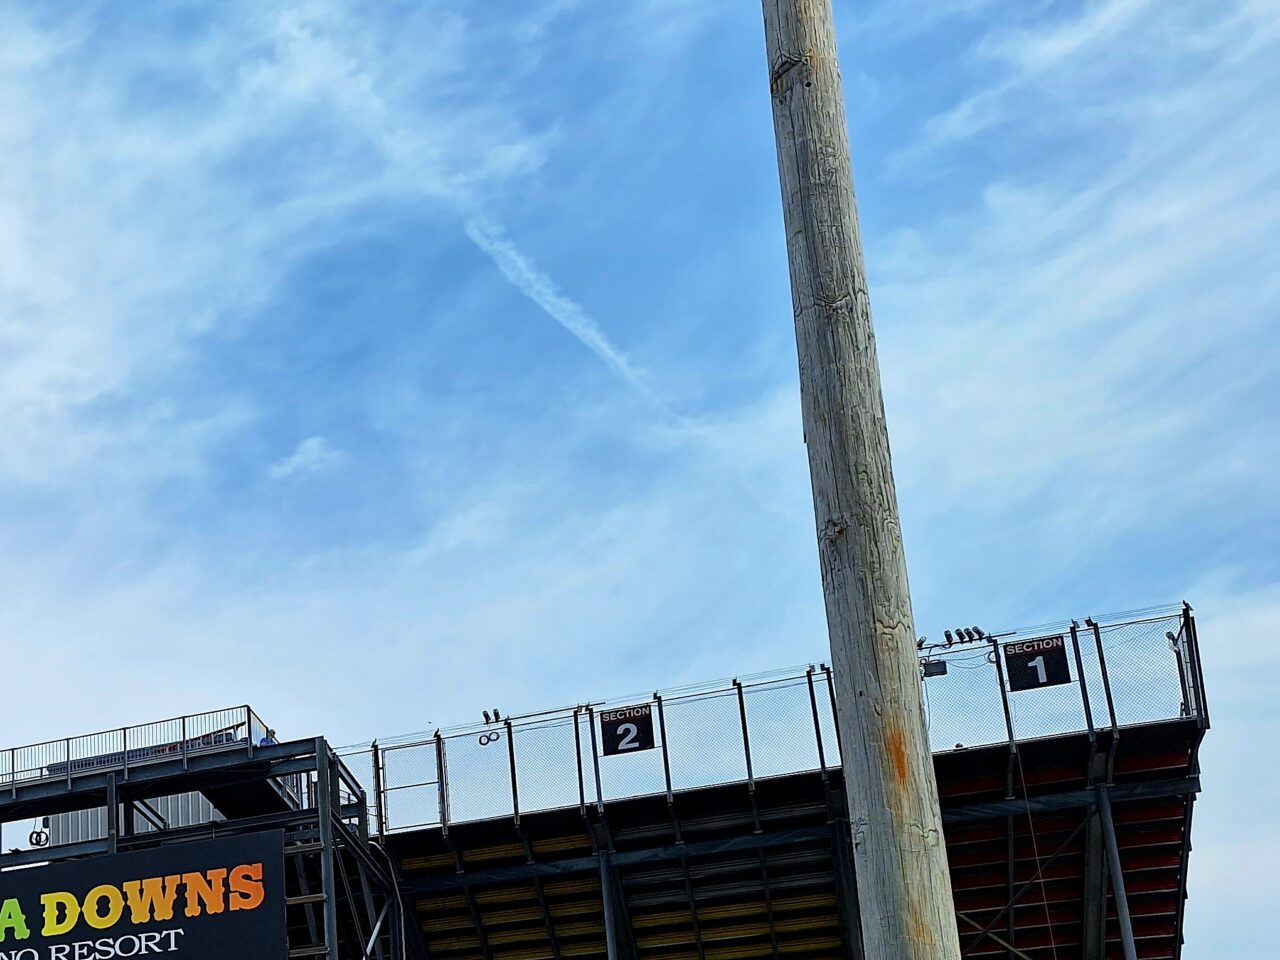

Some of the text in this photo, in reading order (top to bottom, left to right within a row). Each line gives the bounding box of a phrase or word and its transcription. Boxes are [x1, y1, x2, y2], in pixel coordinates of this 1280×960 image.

[1006, 638, 1062, 655] SECTION
[1027, 655, 1047, 683] 1
[602, 707, 650, 722] SECTION
[616, 723, 639, 750] 2
[40, 862, 265, 937] DOWNS
